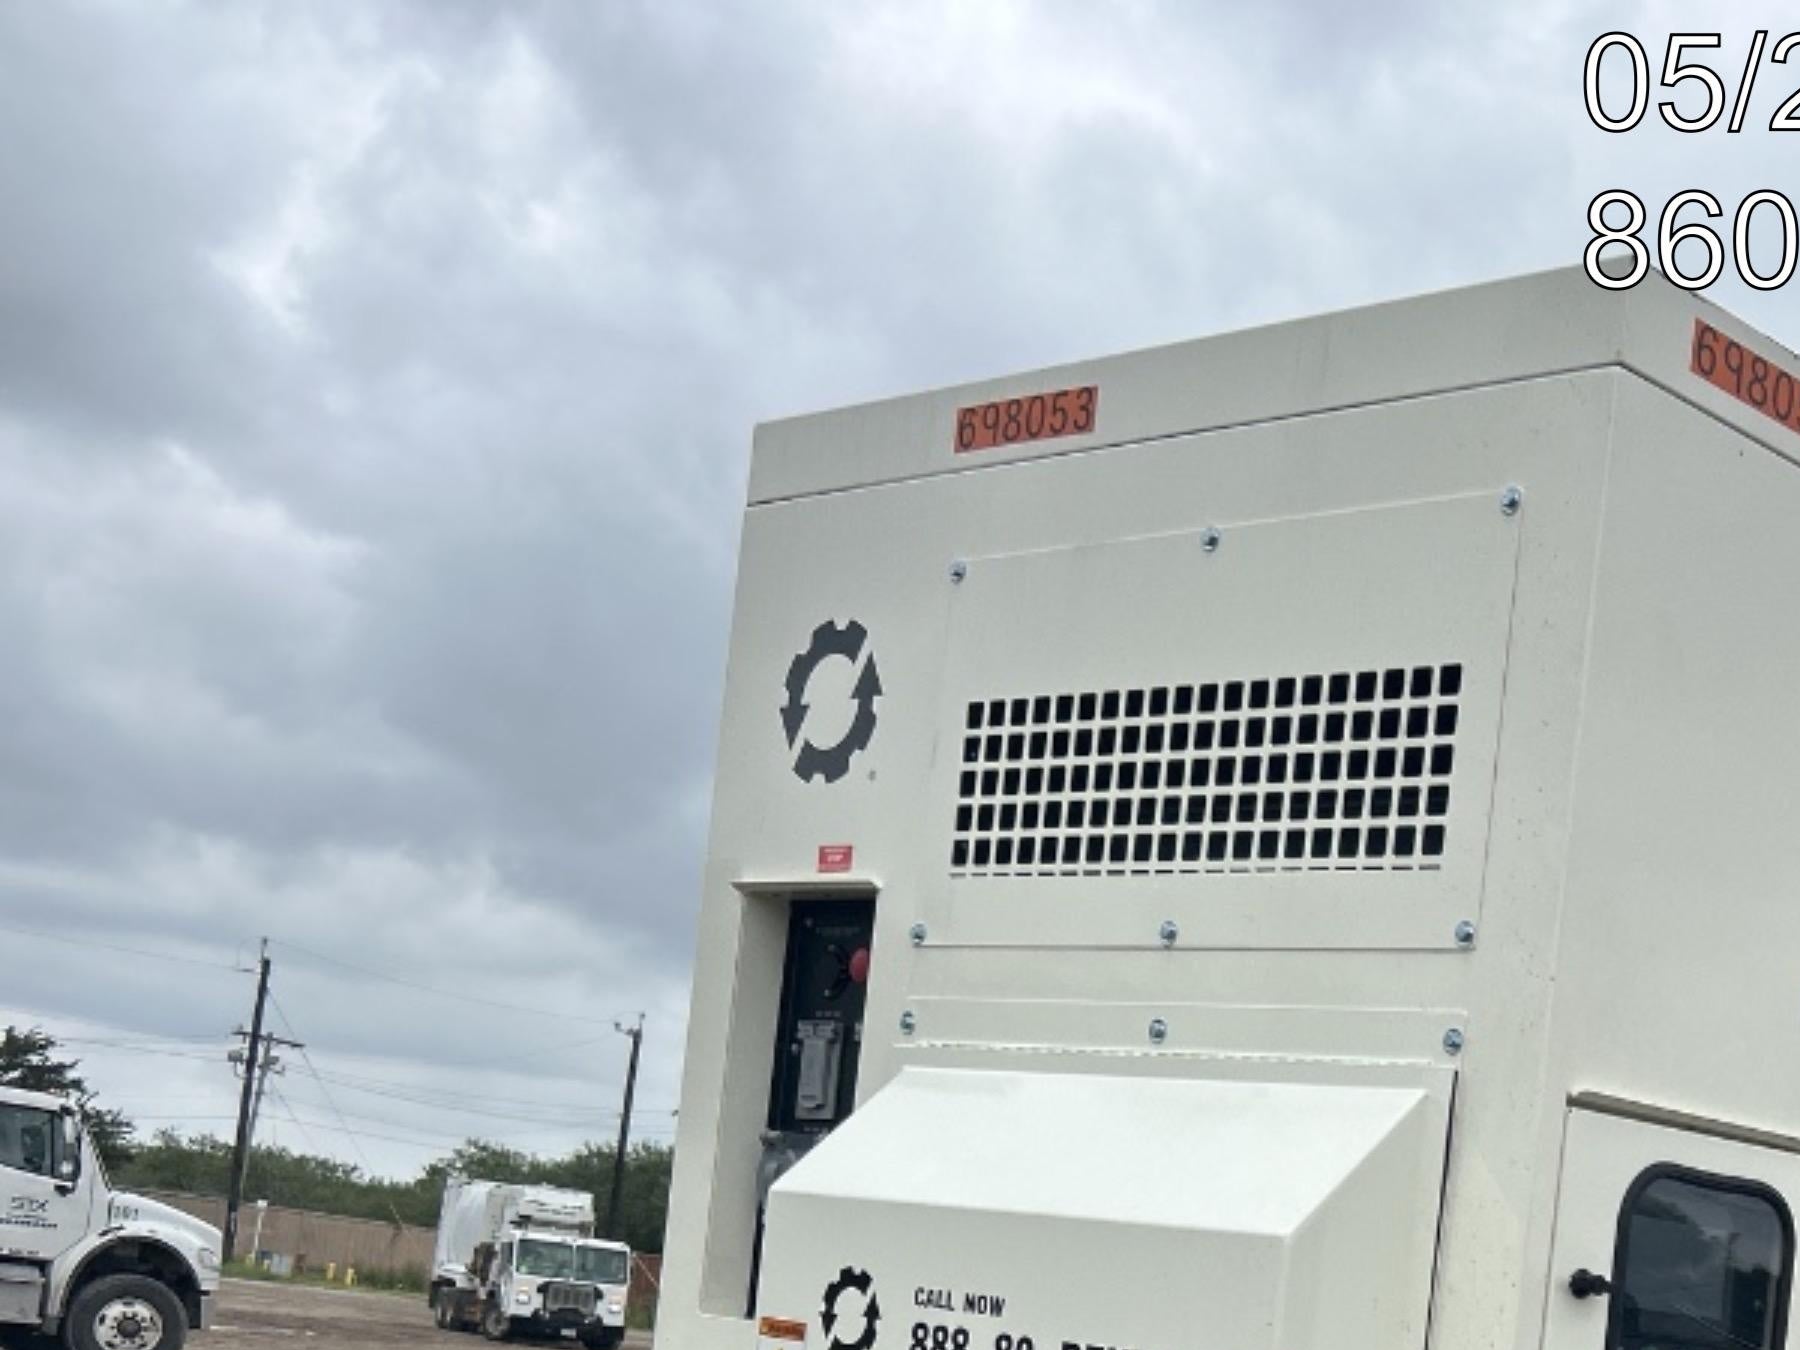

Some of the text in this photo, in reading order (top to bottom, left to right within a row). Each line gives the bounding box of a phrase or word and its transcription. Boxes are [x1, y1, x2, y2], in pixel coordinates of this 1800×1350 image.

[957, 386, 1093, 450] 698053
[913, 1286, 1007, 1318] CALL NOW
